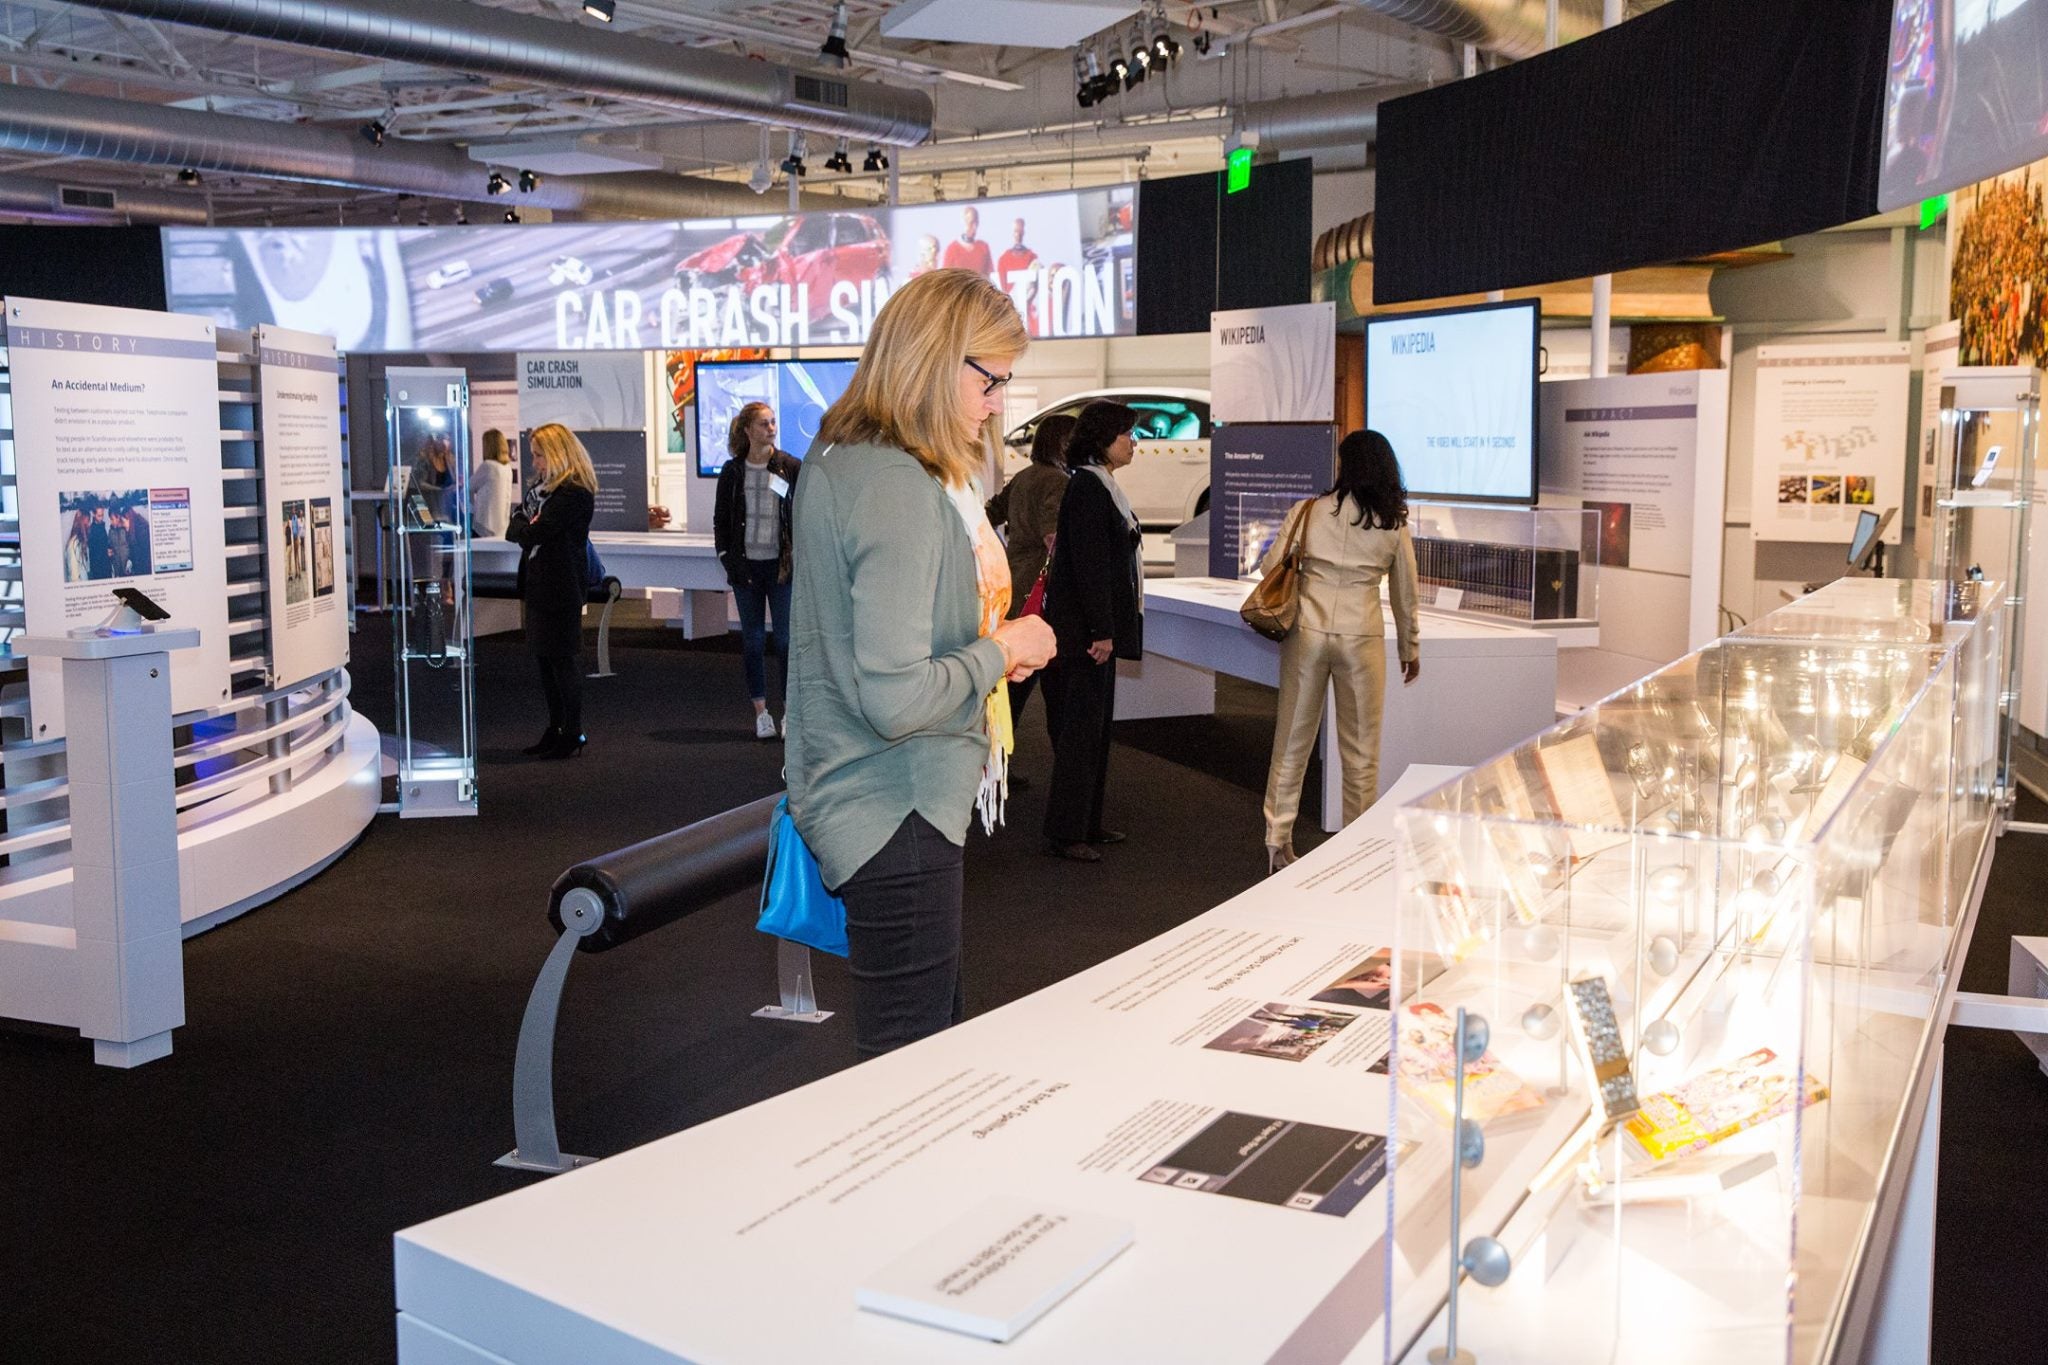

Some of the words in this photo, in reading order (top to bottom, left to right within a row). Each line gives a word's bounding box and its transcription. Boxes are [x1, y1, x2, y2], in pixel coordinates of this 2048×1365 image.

[556, 290, 642, 349] CAR
[660, 283, 809, 347] CRASH
[830, 262, 1115, 345] SITION
[21, 329, 138, 353] HISTORY
[1220, 326, 1265, 346] WIKIPEDIA
[1391, 332, 1436, 355] WIKIPEDIA
[263, 350, 309, 368] HISTORY
[527, 360, 546, 374] CAR
[548, 360, 579, 374] CRASH
[51, 379, 63, 390] An
[65, 380, 108, 392] Accidental
[110, 382, 146, 393] Medium?
[527, 375, 582, 389] SIMULATION
[1583, 408, 1634, 420] IMPACT
[1224, 452, 1233, 460] The
[1234, 452, 1250, 460] Answer
[1251, 452, 1264, 460] Place
